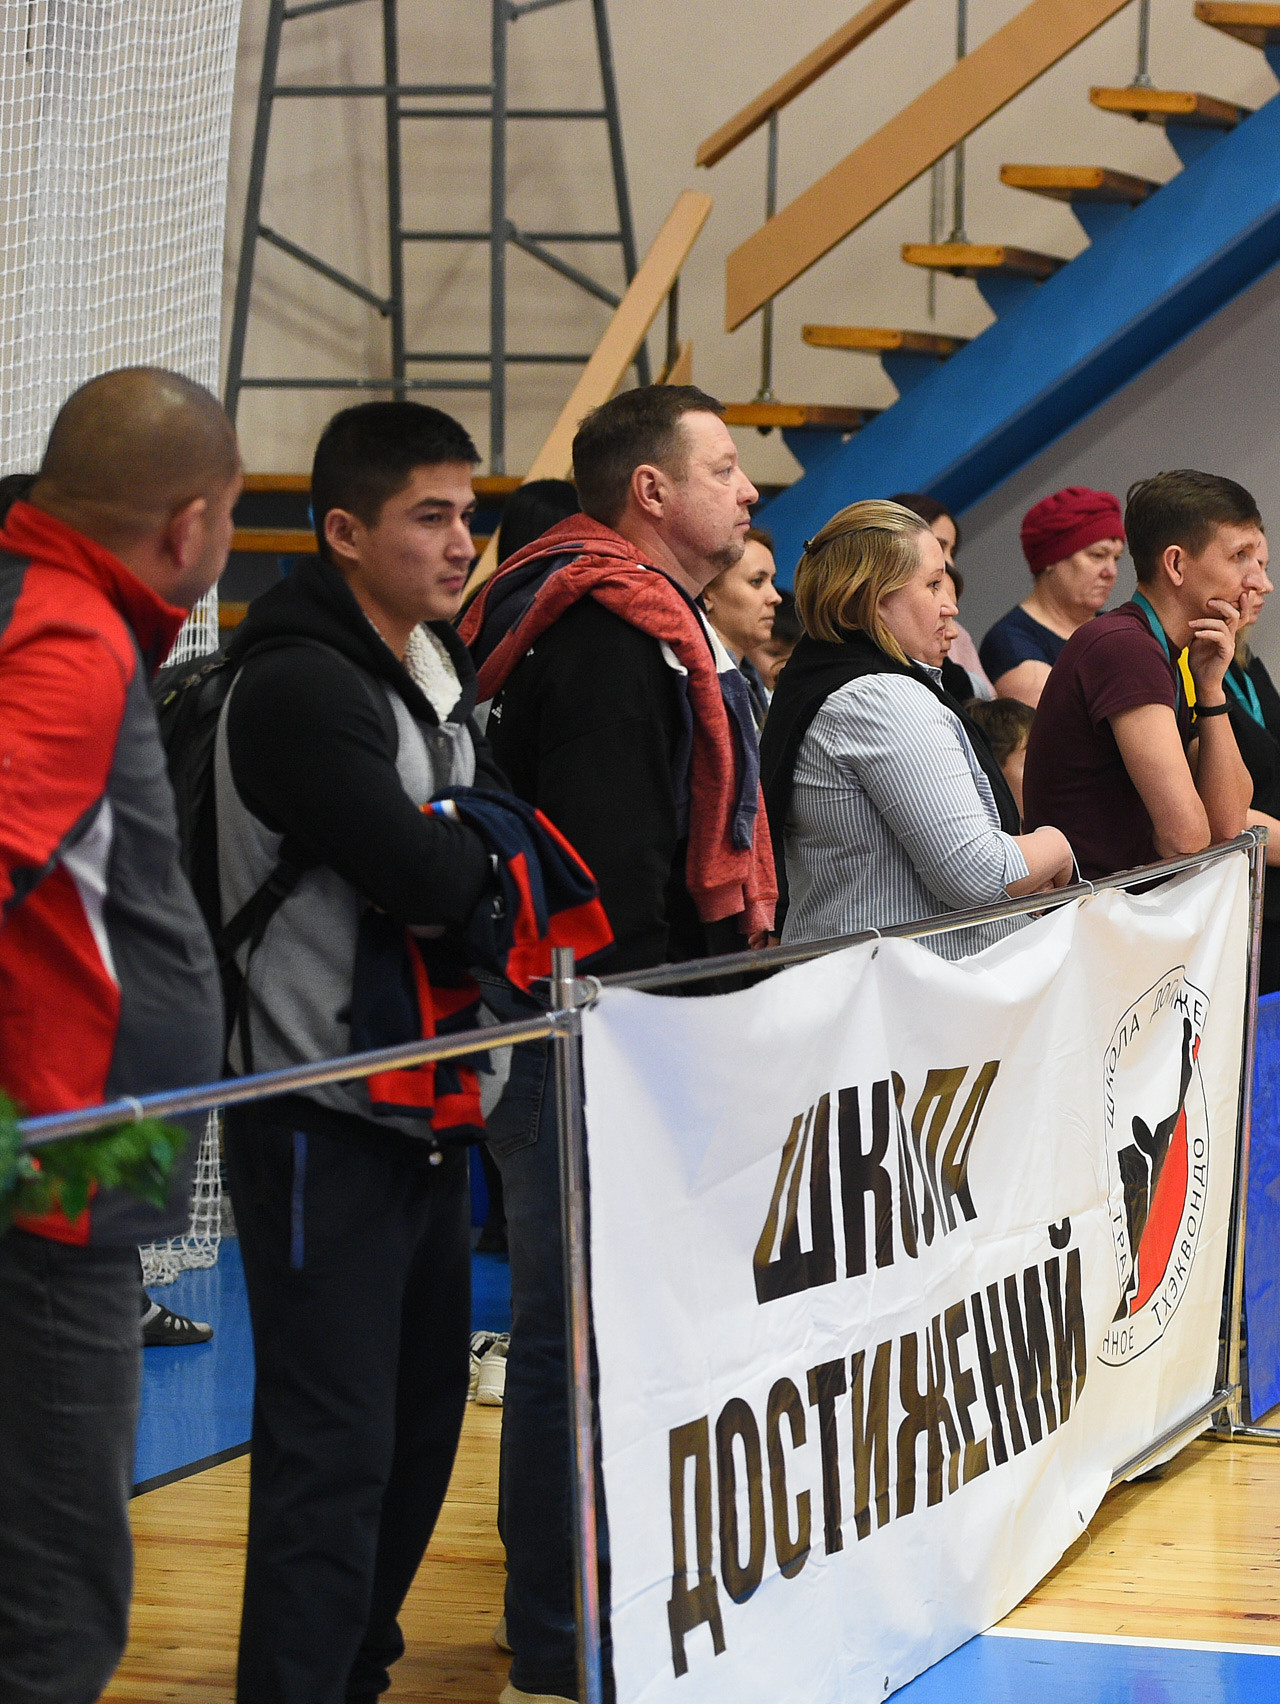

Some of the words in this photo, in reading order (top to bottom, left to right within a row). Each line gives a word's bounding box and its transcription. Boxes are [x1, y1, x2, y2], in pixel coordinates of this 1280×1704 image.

[753, 1060, 1001, 1304] ШКОЛА
[1151, 1138, 1206, 1326] ТХЭКВОНДО
[667, 1217, 1086, 1678] ДОСТИЖЕНИЙ
